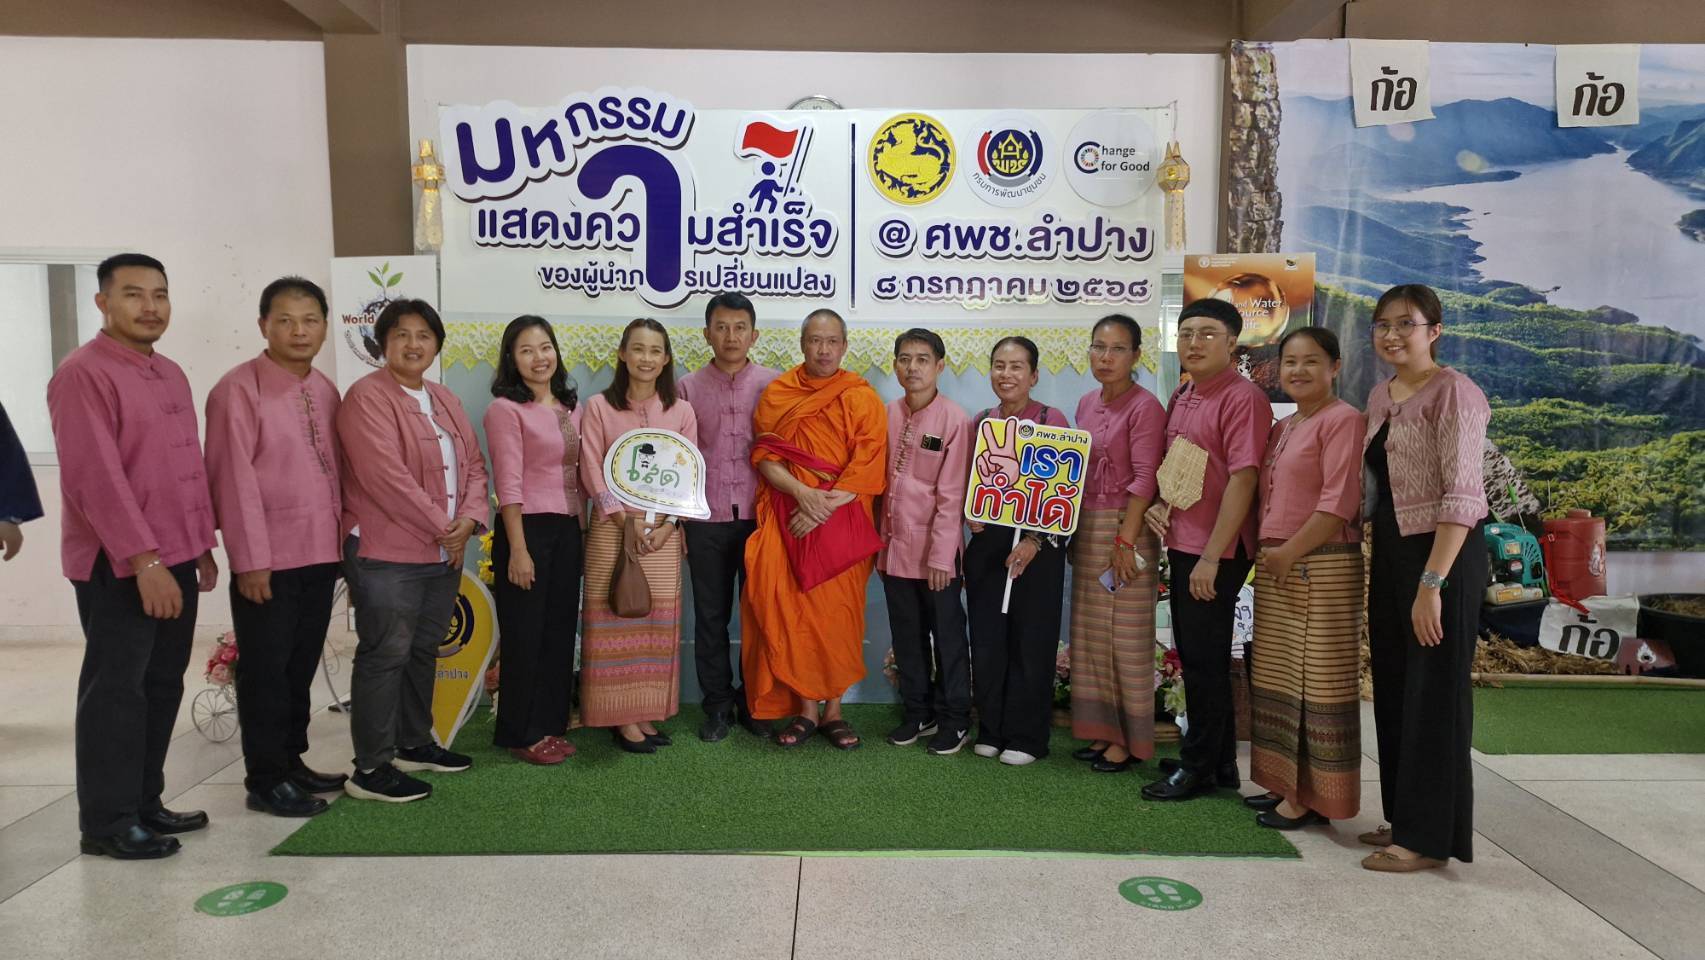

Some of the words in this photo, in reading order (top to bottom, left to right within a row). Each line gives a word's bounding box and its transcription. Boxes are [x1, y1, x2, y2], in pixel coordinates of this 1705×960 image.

[1370, 66, 1418, 111] ก้อ
[1572, 72, 1625, 116] ก้อ
[456, 96, 687, 186] มหกรรม
[1101, 160, 1117, 171] for
[1120, 161, 1150, 171] Good
[878, 219, 911, 250] @
[925, 213, 1147, 252] ศพช.ลำปาง
[876, 275, 896, 294] ๘
[907, 275, 1047, 301] กรกฎาคม
[1056, 276, 1148, 298] ๒๕๖๘
[342, 314, 375, 324] World
[1237, 308, 1269, 317] ource
[1036, 431, 1088, 444] ศพช.ลำปาง
[1021, 444, 1083, 482] เรา
[972, 473, 1078, 530] ทำได้
[1558, 614, 1620, 660] ก้อ
